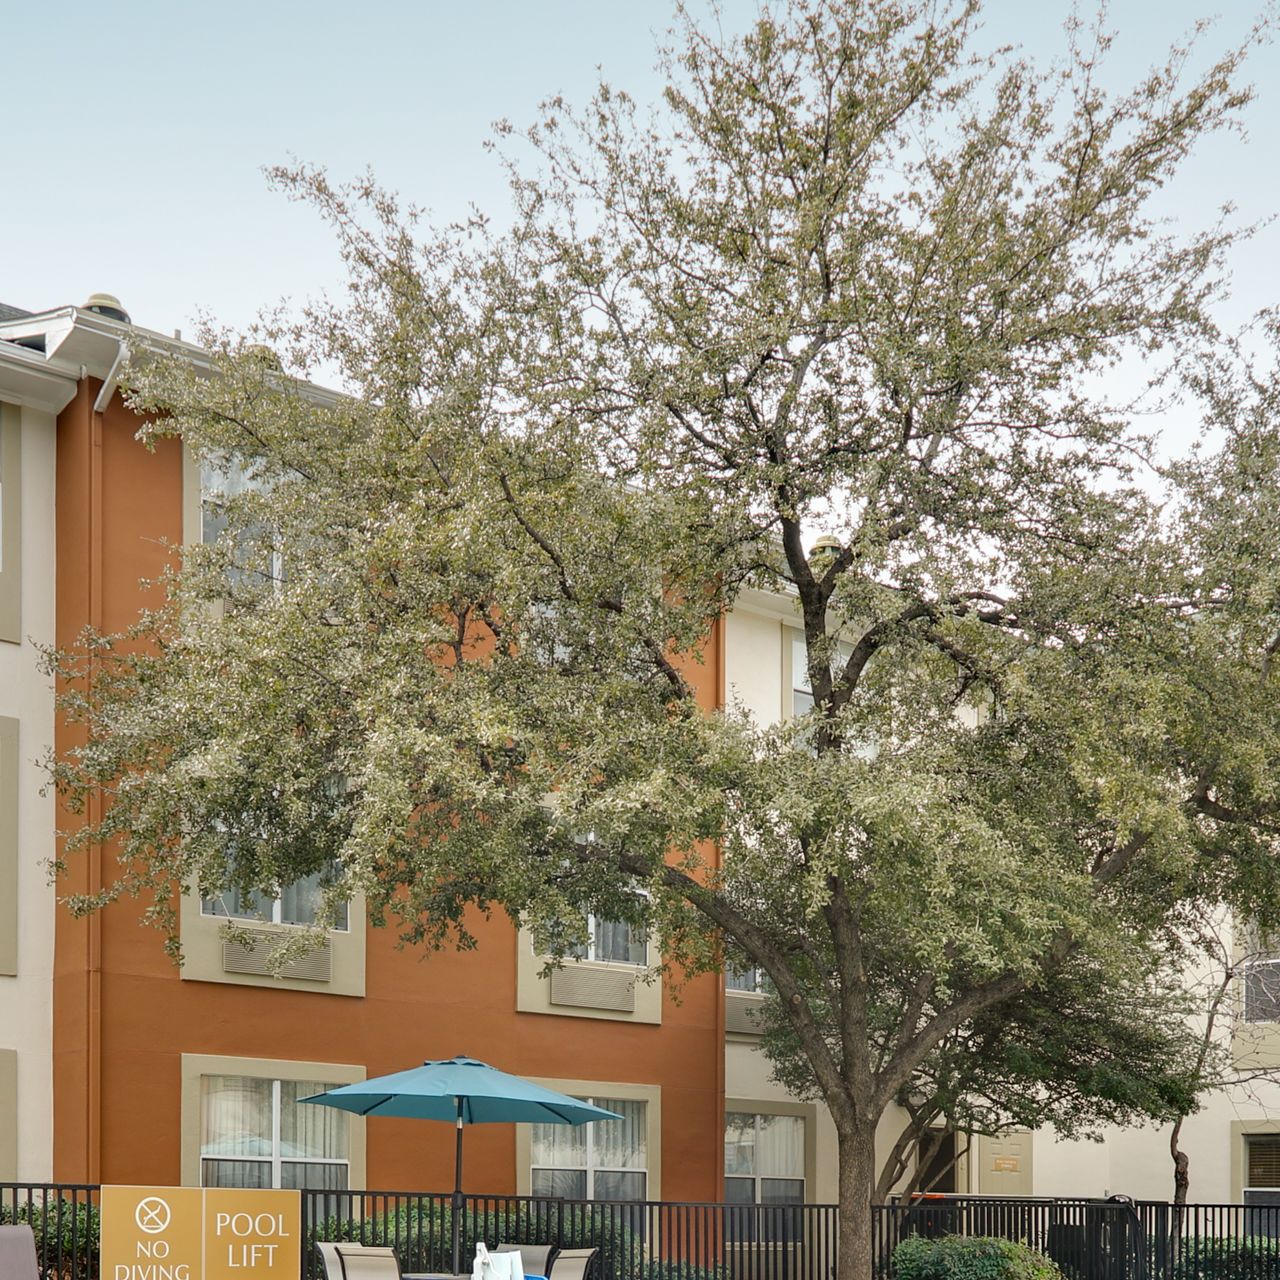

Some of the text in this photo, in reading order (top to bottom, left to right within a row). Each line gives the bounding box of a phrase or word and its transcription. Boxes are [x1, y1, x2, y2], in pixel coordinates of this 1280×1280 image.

[216, 1212, 290, 1237] POOL
[136, 1240, 170, 1258] NO
[228, 1244, 279, 1267] LIFT
